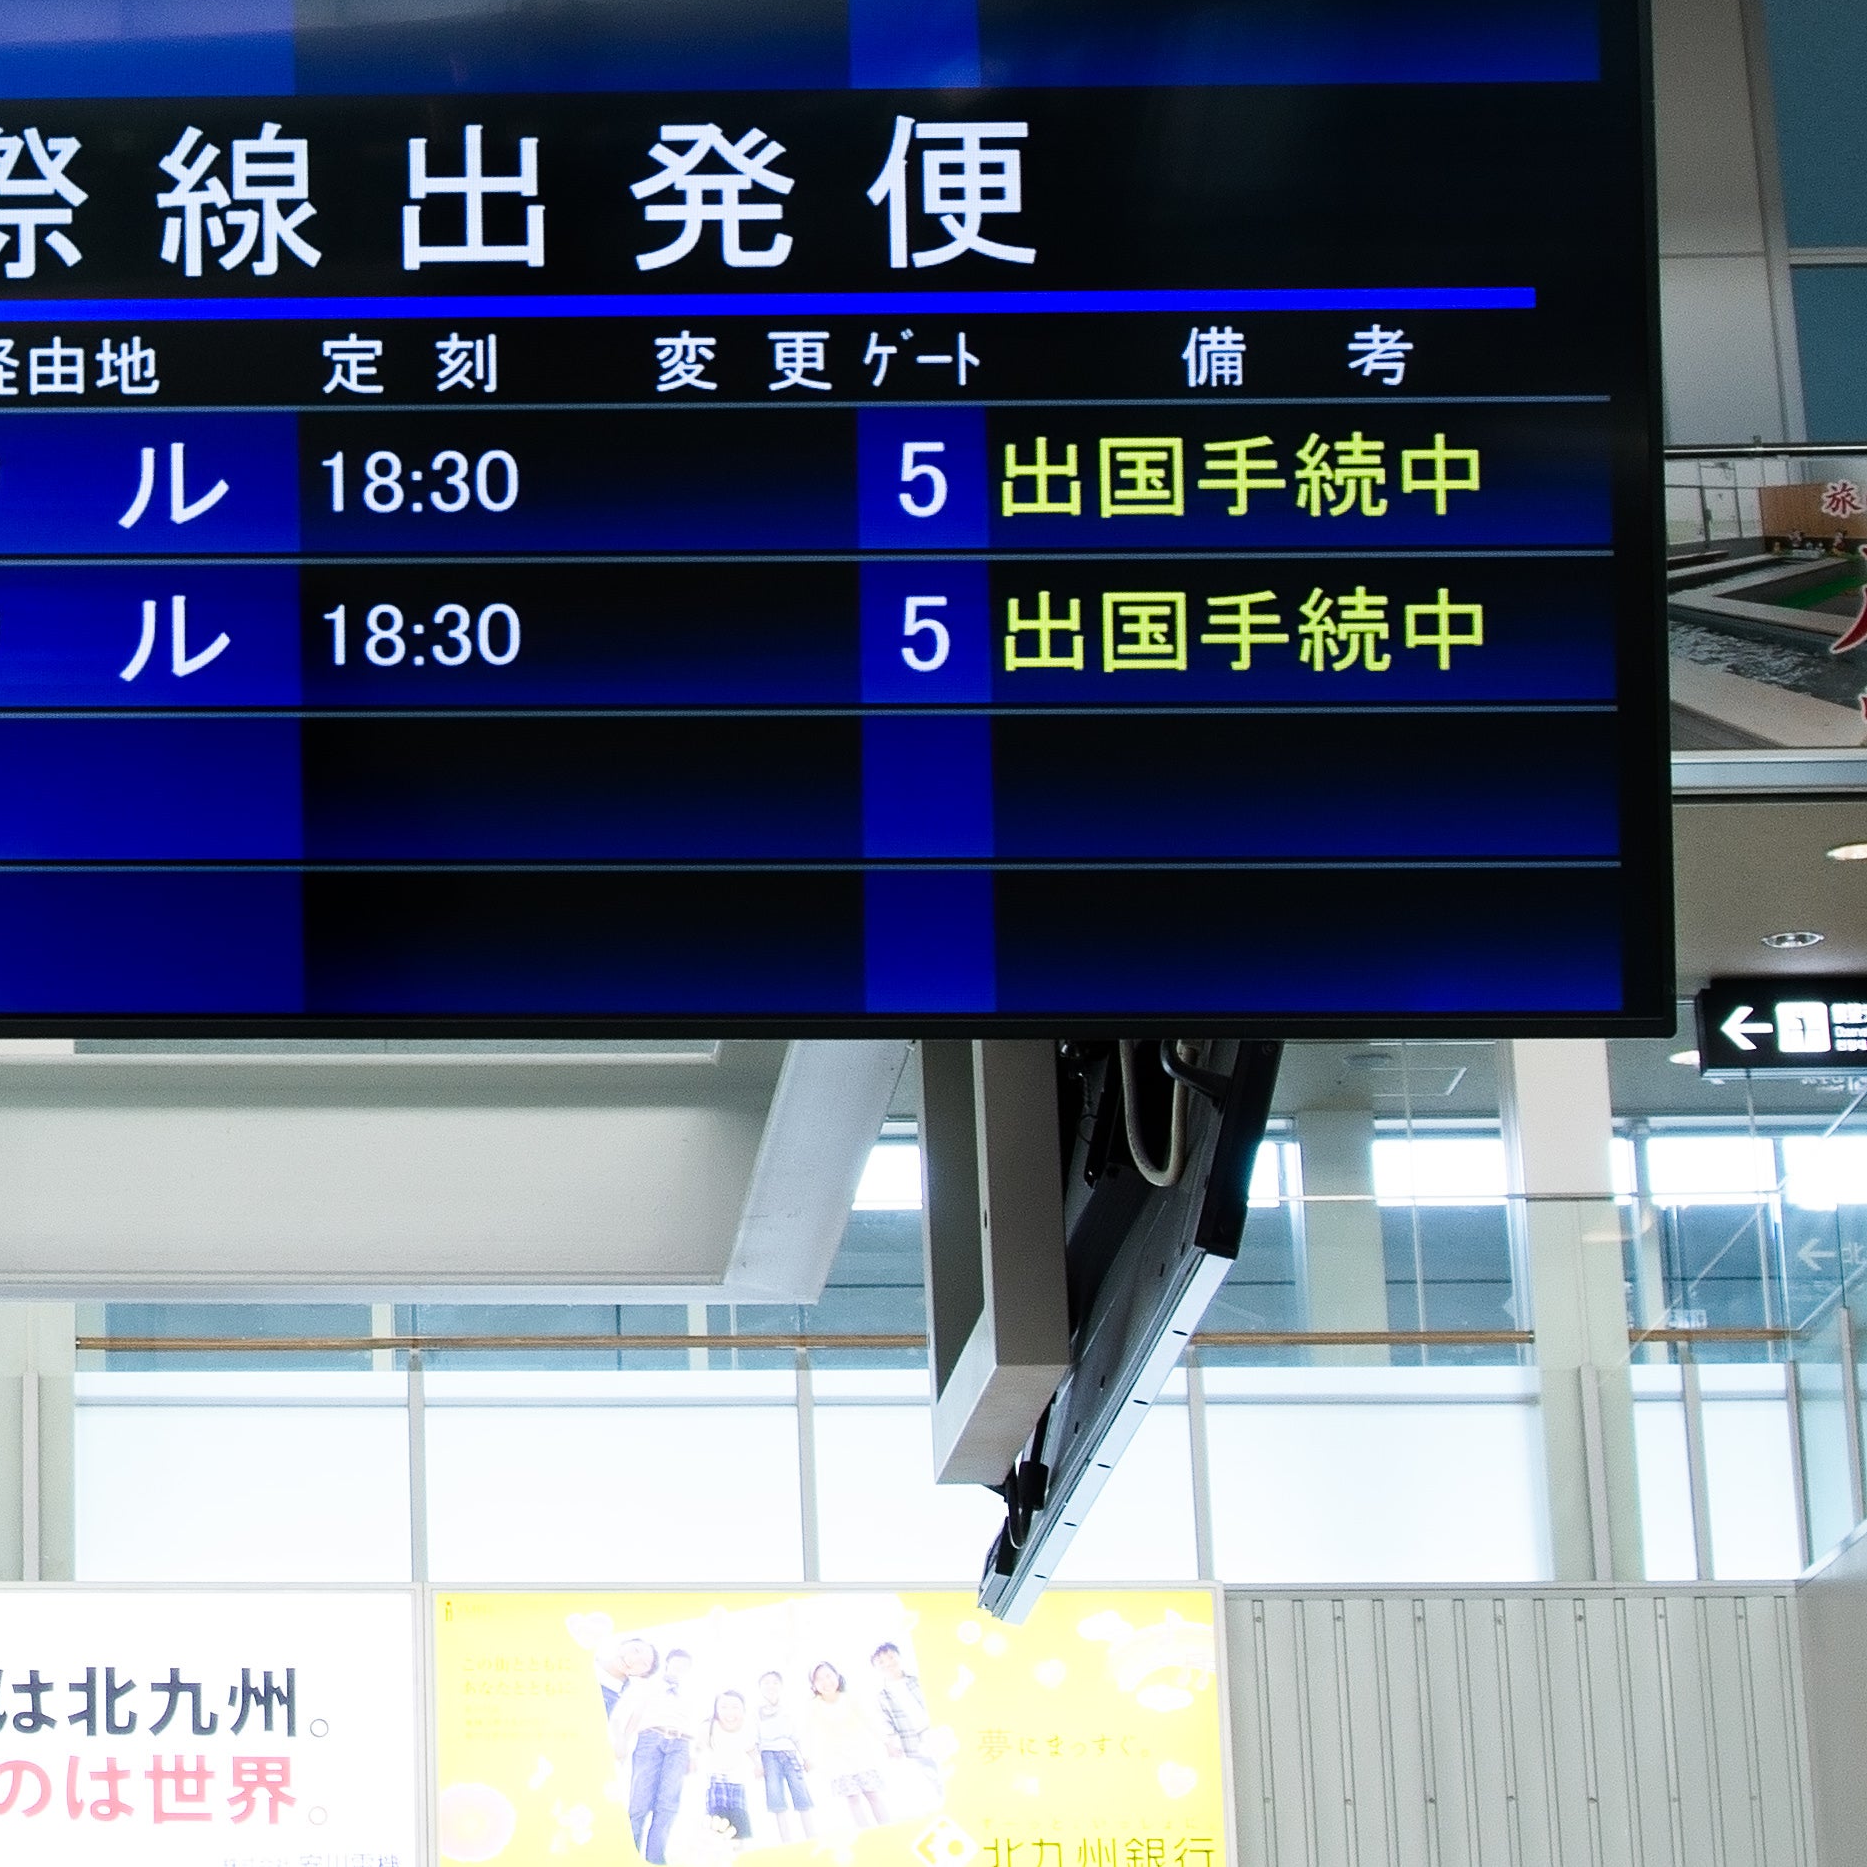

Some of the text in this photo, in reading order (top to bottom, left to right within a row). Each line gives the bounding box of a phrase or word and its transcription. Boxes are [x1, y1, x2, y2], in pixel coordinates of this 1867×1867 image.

[323, 332, 497, 394] 定刻
[655, 330, 832, 392] 変更
[1182, 323, 1414, 388] 備考
[322, 449, 519, 513] 18:30
[899, 441, 948, 517] 5
[1002, 431, 1480, 519] 出国手続中
[324, 603, 521, 666] 18:30
[901, 596, 950, 672] 5
[1005, 585, 1484, 673] 出国手続中
[983, 1837, 1216, 1867] 北九州銀行
